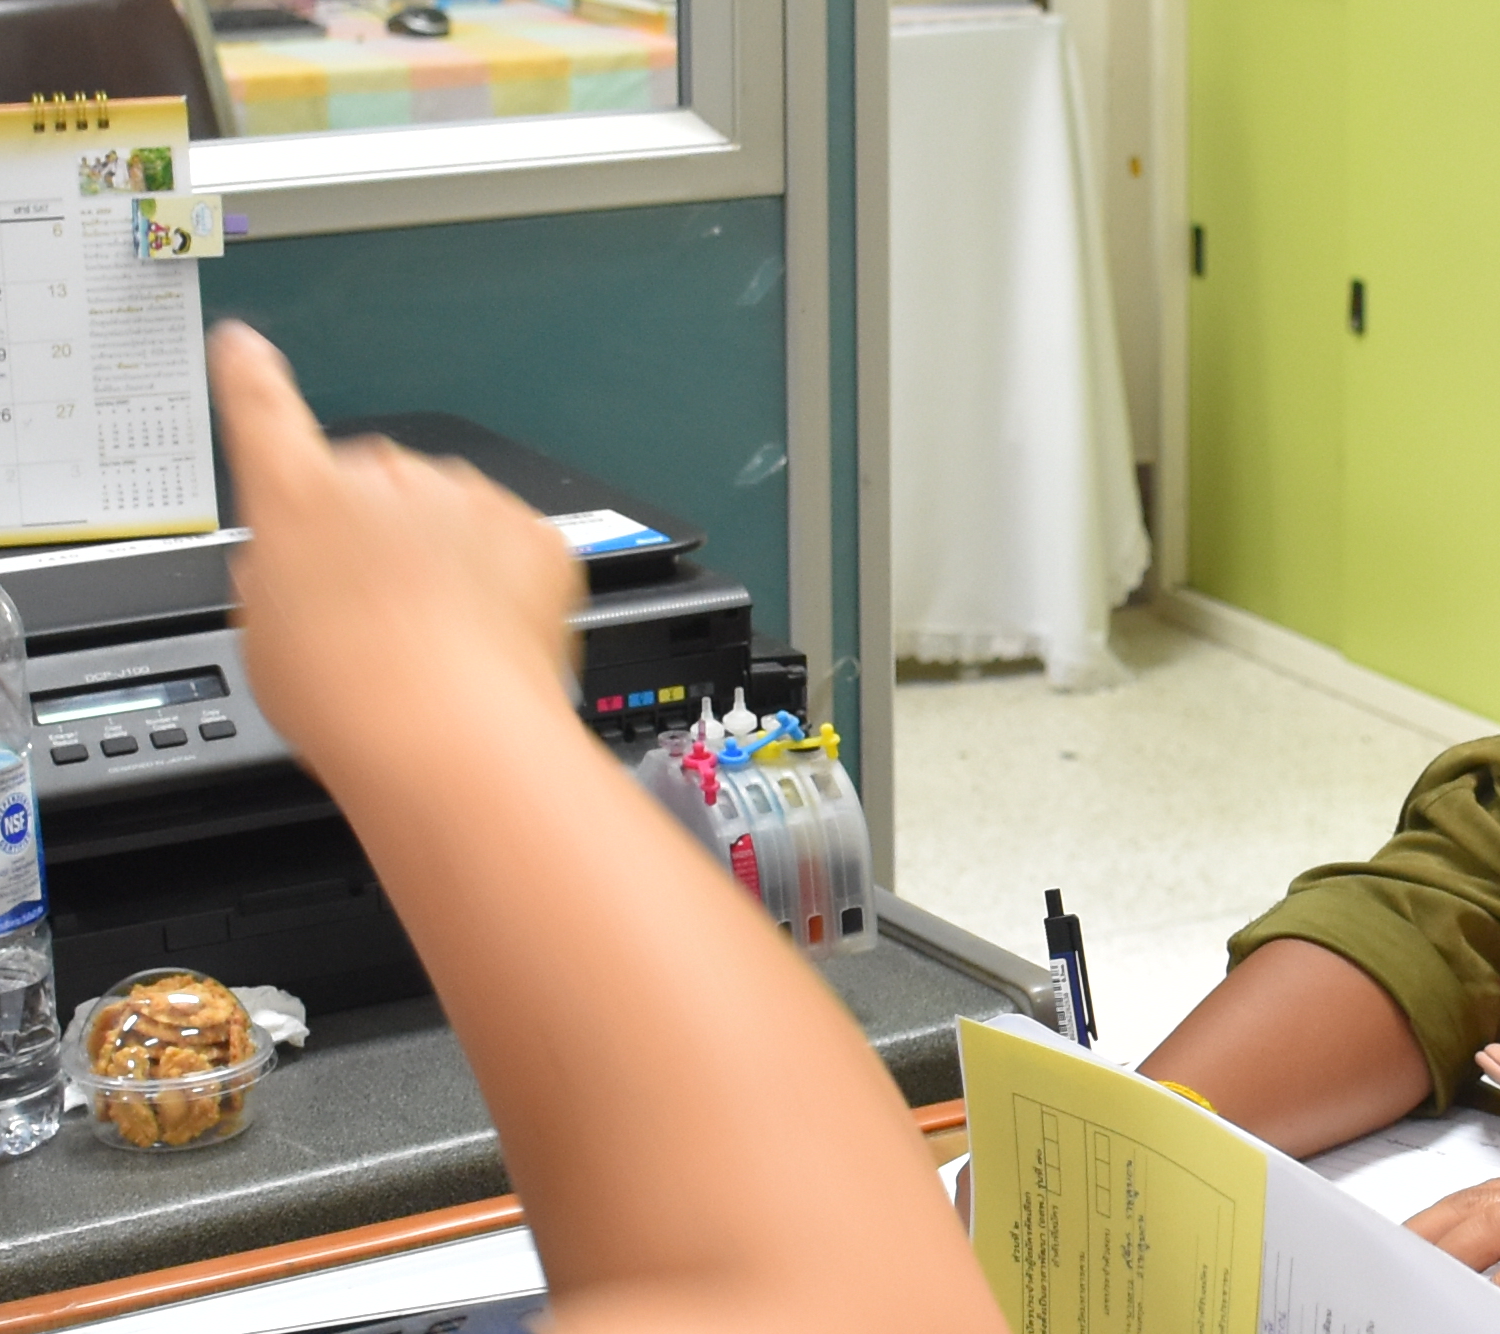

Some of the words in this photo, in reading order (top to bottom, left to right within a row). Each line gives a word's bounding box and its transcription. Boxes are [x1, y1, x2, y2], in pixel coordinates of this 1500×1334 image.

[53, 224, 64, 238] 6
[48, 284, 68, 298] 13
[52, 344, 72, 358] 20
[56, 404, 76, 419] 27
[3, 810, 26, 837] NSF
